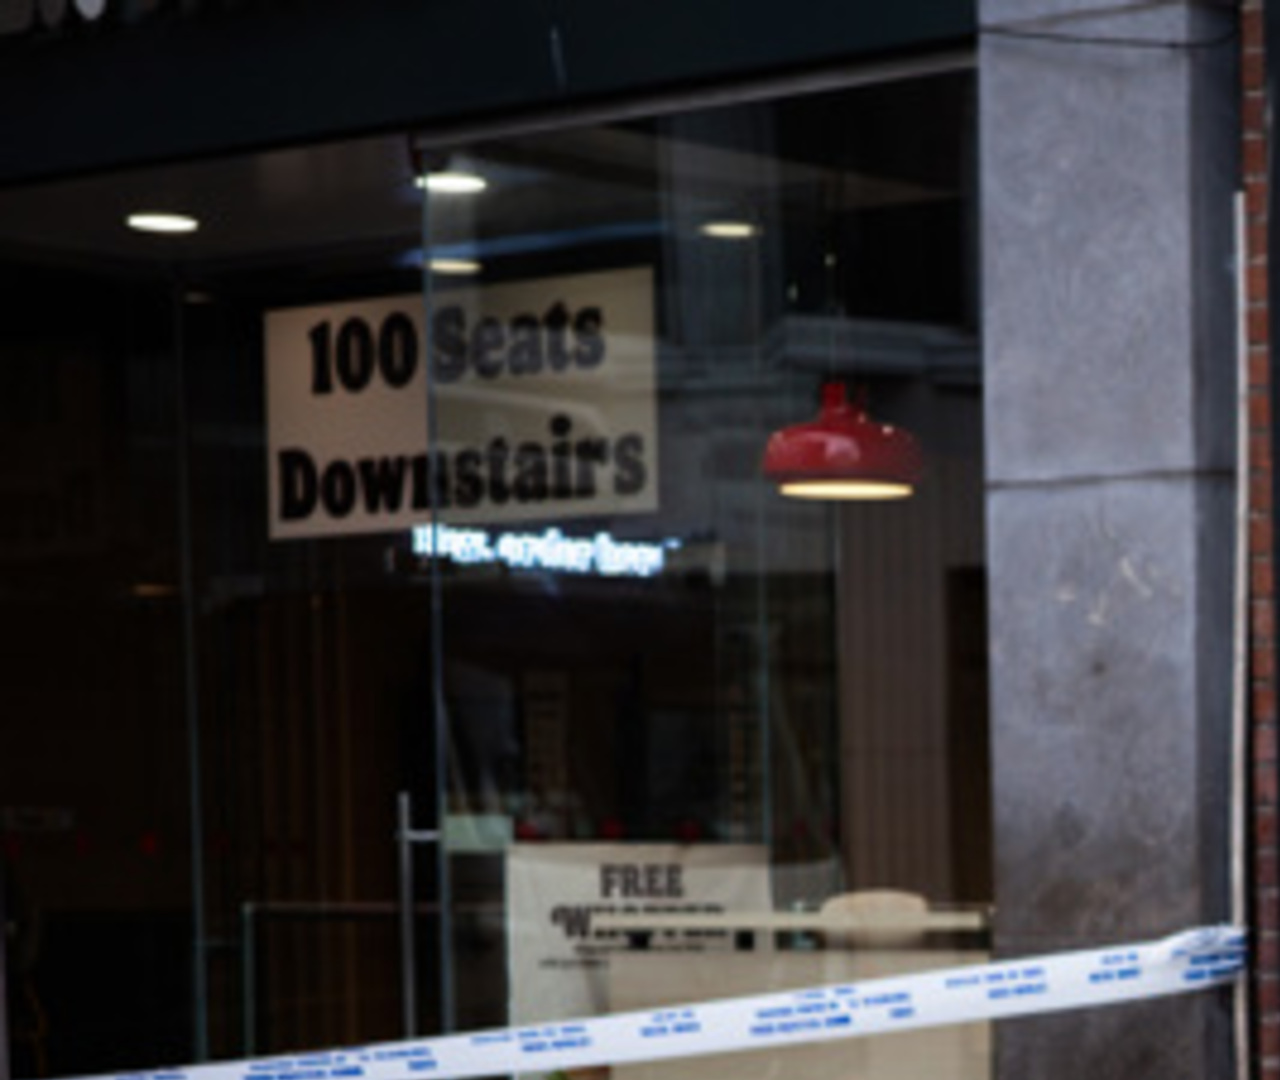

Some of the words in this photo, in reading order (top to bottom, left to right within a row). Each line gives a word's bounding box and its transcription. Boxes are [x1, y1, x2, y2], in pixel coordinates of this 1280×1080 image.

[308, 311, 418, 395] 100
[432, 302, 606, 384] Seats
[278, 414, 648, 522] Downstairs
[601, 864, 684, 899] FREE
